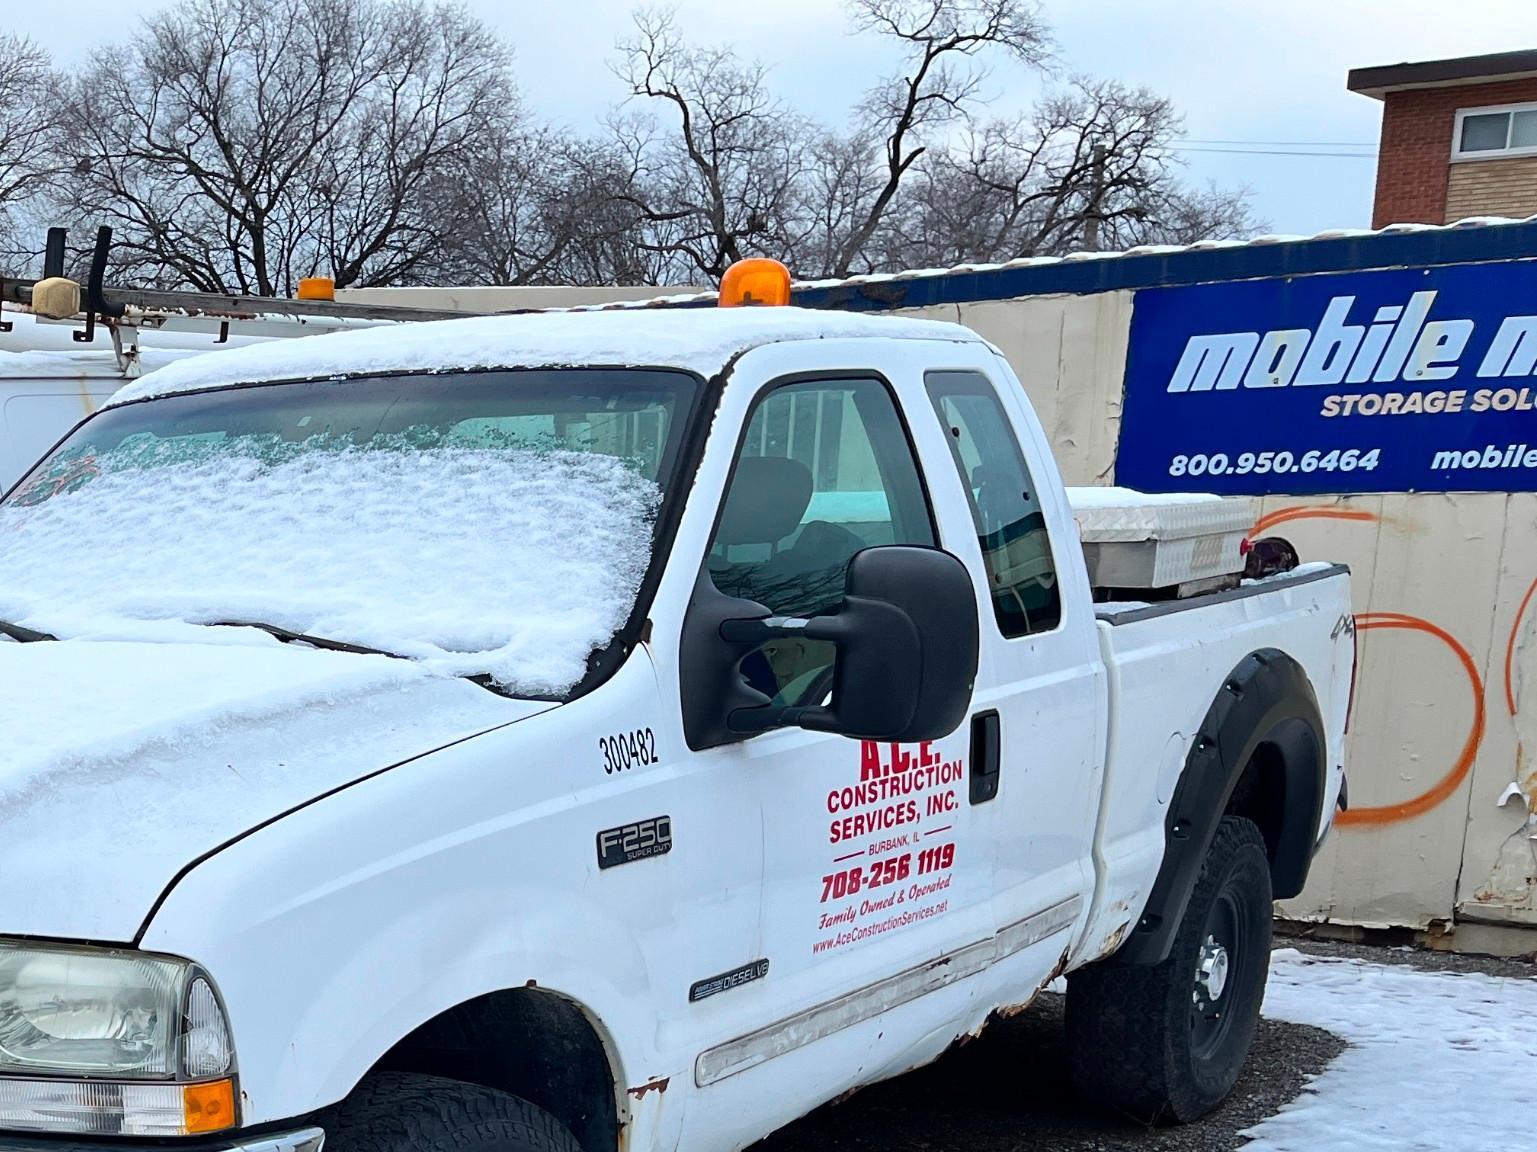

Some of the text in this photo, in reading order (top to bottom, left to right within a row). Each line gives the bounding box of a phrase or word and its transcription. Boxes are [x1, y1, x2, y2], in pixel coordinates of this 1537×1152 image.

[1167, 290, 1475, 393] mobile
[1320, 387, 1537, 418] STORAGE SOL
[1169, 447, 1381, 477] 800.950.6464
[598, 726, 659, 775] 300482
[827, 759, 963, 814] CONSTRUCTION
[829, 790, 959, 844] SERVICES, INC.
[627, 847, 652, 860] SUPER
[868, 831, 920, 856] BURBANK, IL
[820, 843, 955, 904] 708-256 1119
[812, 900, 948, 954] www.AceConstructionServices.net
[818, 873, 953, 930] Family Owned & Operated
[724, 967, 757, 989] DIESEL
[756, 962, 769, 977] V8
